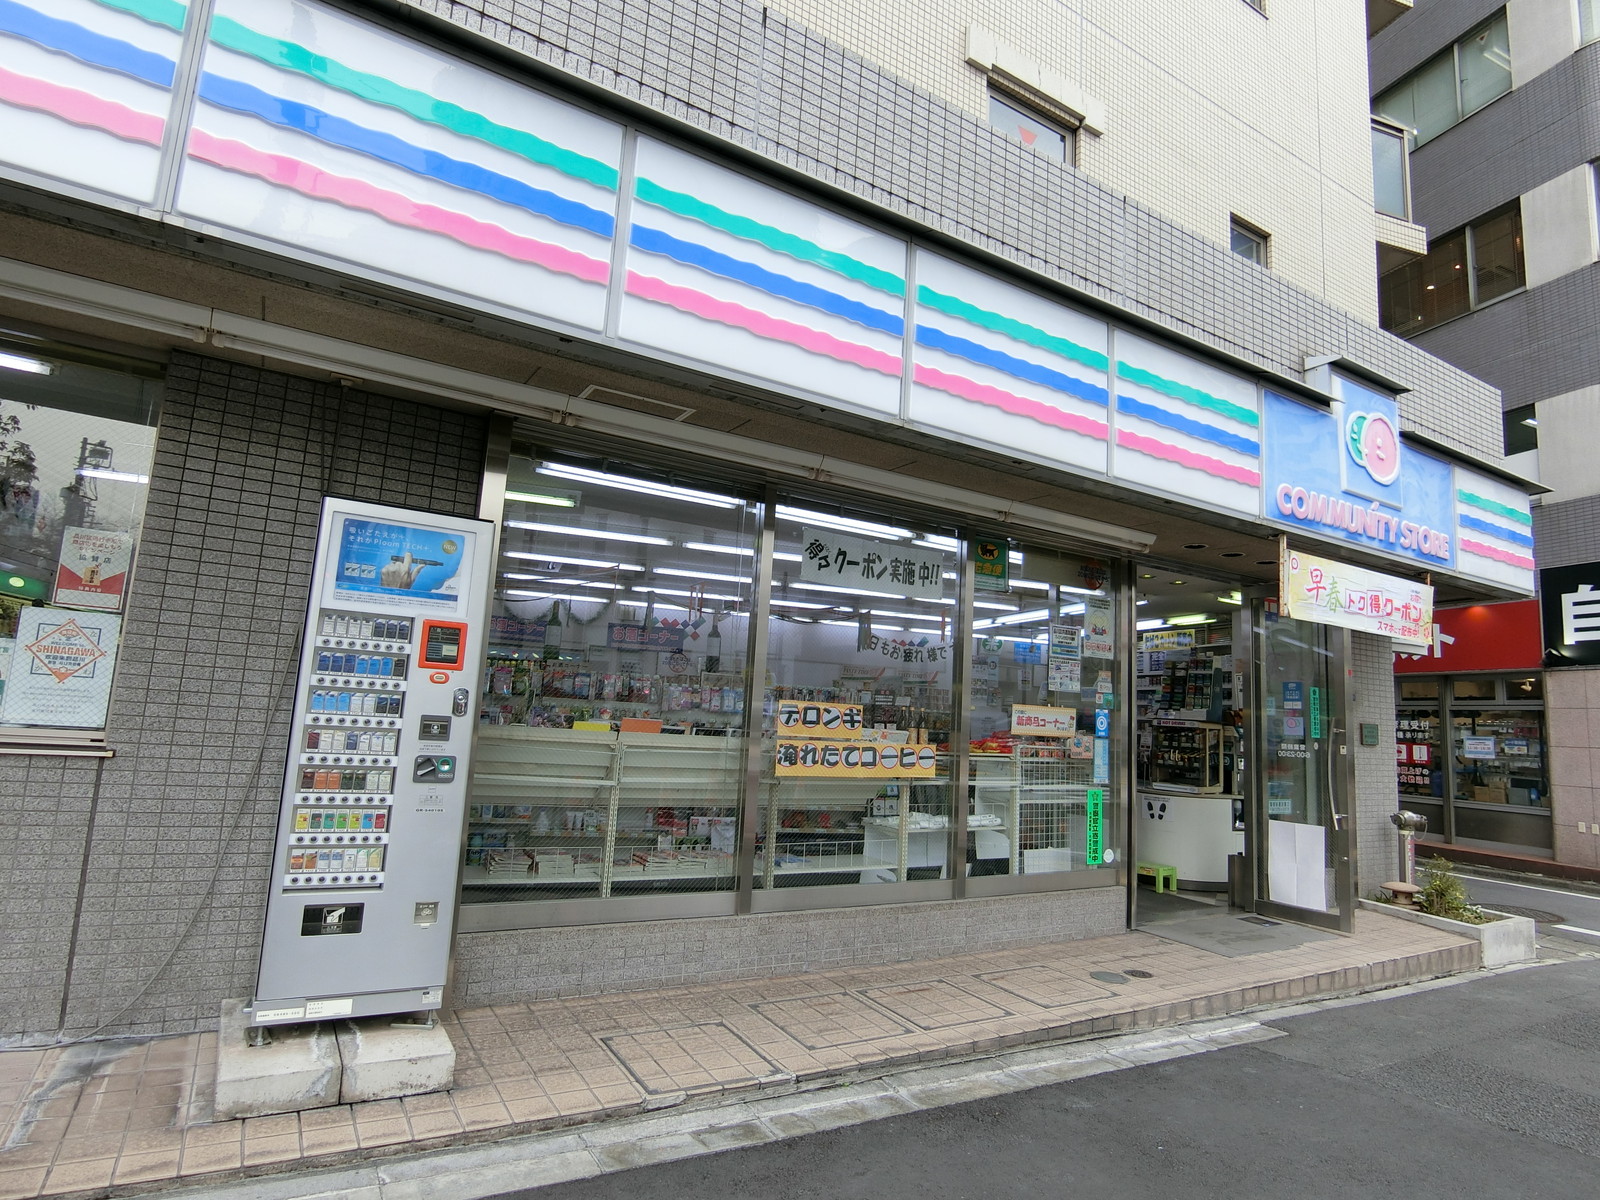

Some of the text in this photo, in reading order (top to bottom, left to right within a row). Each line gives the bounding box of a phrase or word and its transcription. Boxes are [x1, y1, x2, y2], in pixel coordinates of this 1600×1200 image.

[1400, 520, 1450, 560] STORE
[442, 543, 457, 552] NEW
[36, 645, 96, 657] SHINAGAWA
[779, 704, 862, 729] デロンギ
[1015, 714, 1066, 728] 新商品コーナー
[1395, 720, 1430, 731] 理受付
[777, 743, 936, 768] 淹れたてコーヒー
